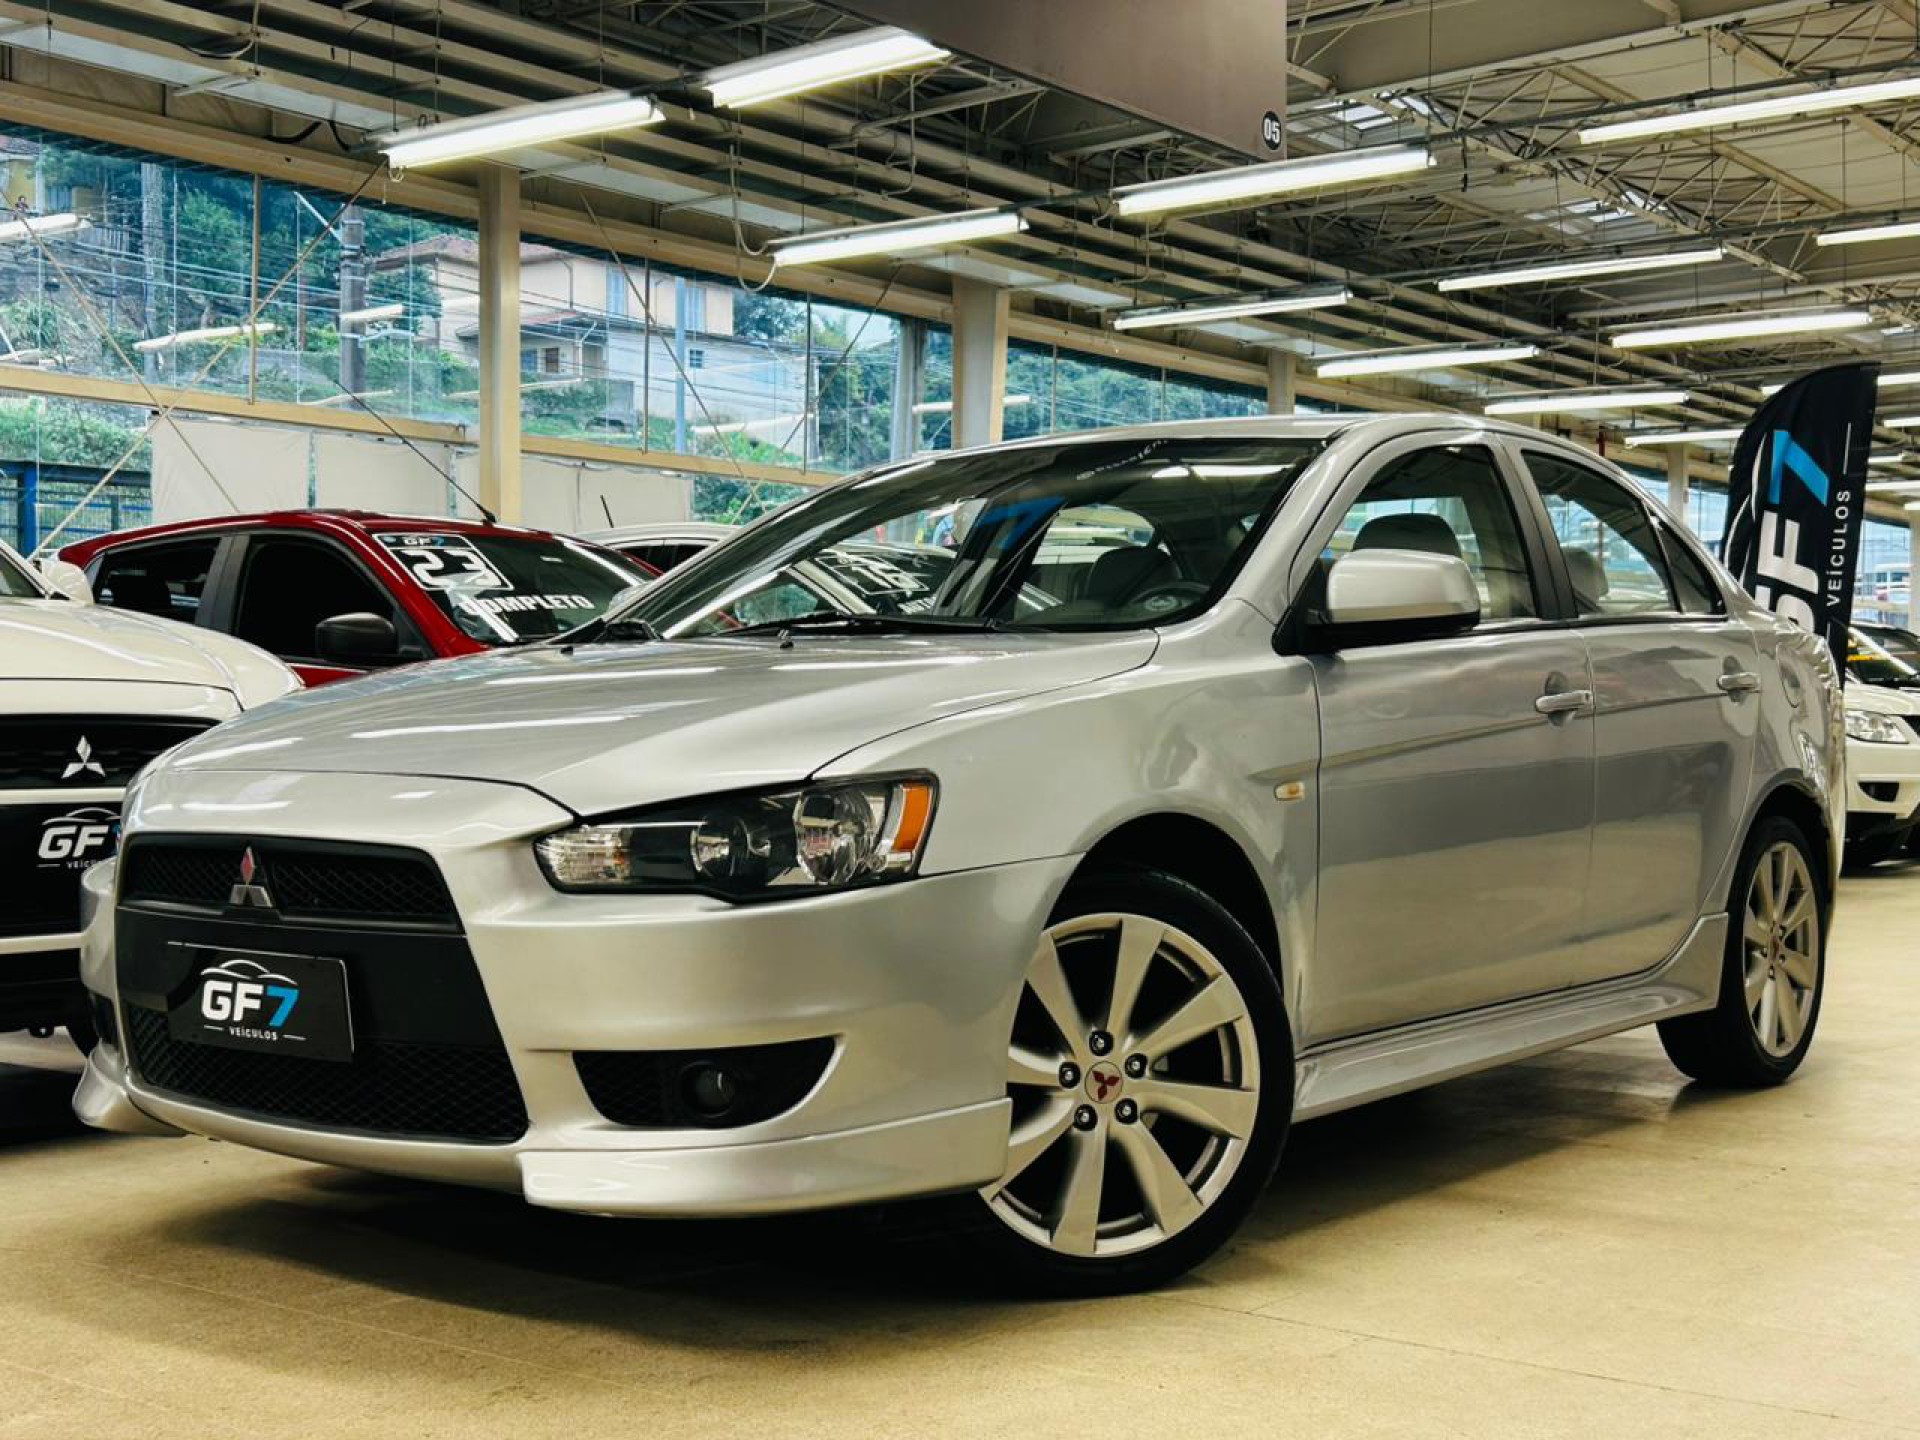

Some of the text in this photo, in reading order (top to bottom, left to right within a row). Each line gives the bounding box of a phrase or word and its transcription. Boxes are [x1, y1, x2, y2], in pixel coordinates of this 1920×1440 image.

[1264, 117, 1280, 144] 05
[401, 549, 502, 586] 23
[459, 594, 595, 616] COMPLETO
[201, 980, 298, 1026] GF7
